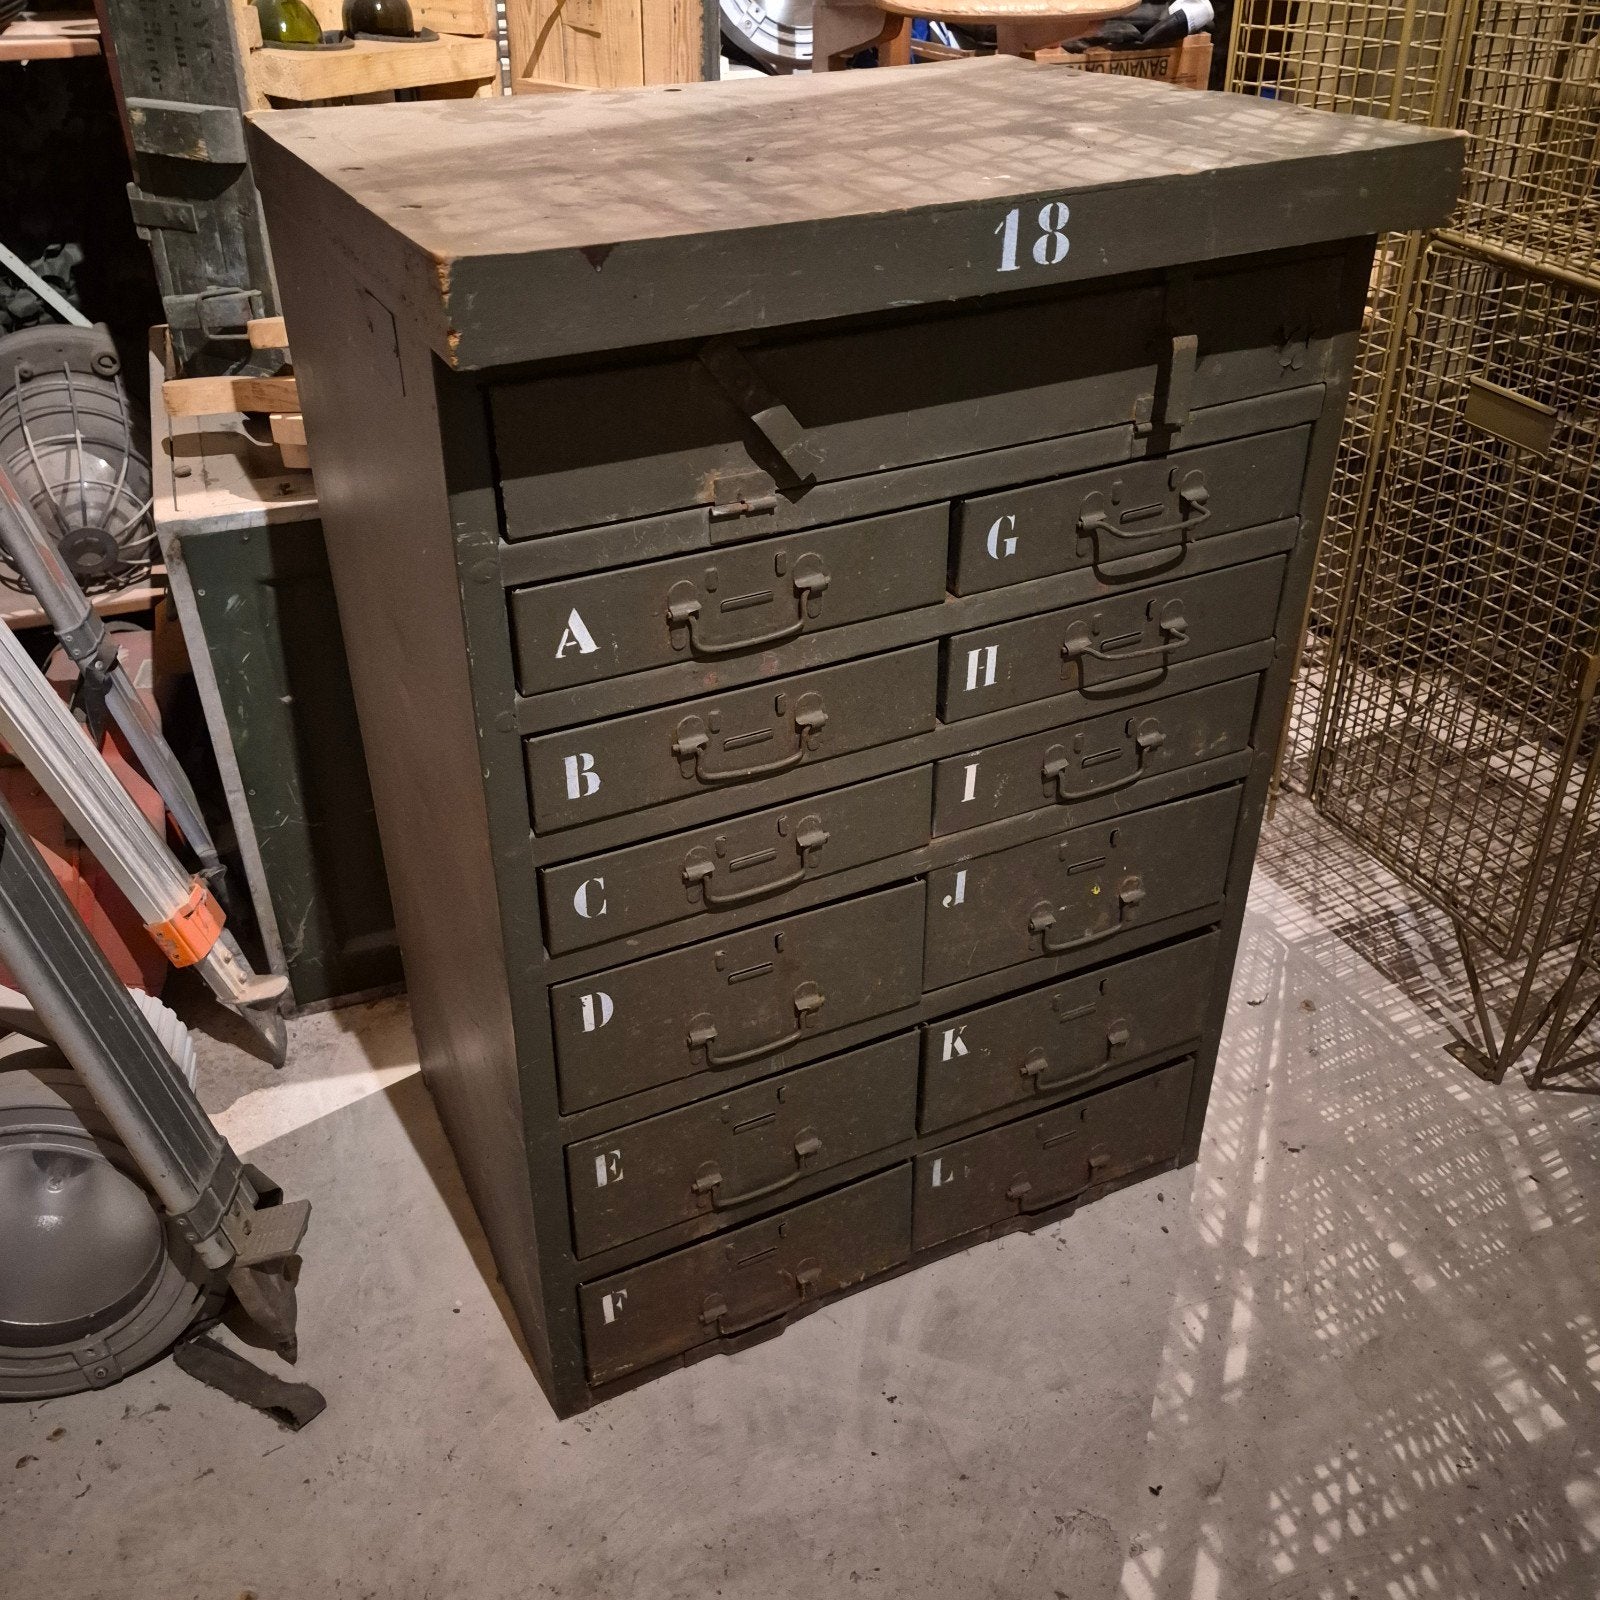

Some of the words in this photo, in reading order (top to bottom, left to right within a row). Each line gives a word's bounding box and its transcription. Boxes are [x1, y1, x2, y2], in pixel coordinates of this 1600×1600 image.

[1110, 59, 1168, 77] BANANA
[994, 202, 1071, 272] 18
[986, 514, 1019, 560] G
[556, 608, 600, 659] A
[964, 644, 999, 692] H
[564, 752, 601, 800] B
[961, 763, 980, 803] I
[573, 877, 607, 919] C
[942, 868, 967, 908] J
[580, 991, 614, 1033] D
[941, 1025, 969, 1062] K
[594, 1149, 624, 1188] E
[931, 1157, 954, 1188] L
[602, 1288, 629, 1325] F
